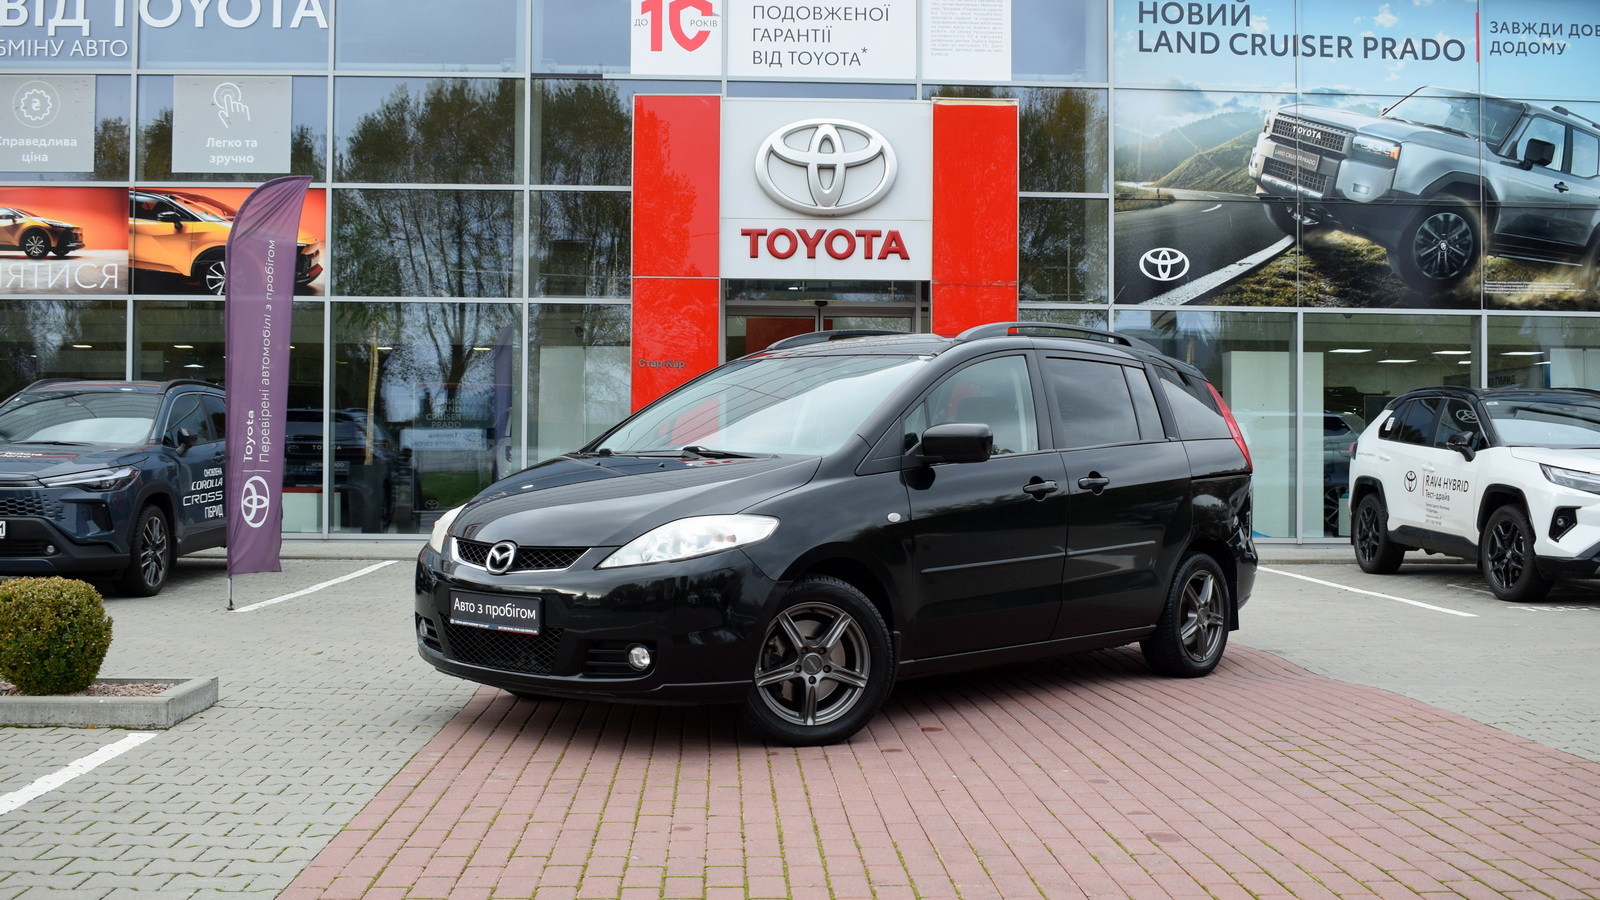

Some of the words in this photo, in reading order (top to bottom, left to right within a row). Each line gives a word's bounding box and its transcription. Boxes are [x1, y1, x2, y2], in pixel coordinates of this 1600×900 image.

[0, 0, 90, 36] ВІД
[752, 4, 891, 23] ПОДОВЖЕНОЇ
[1138, 0, 1251, 26] НОВИЙ
[752, 26, 833, 43] ГАРАНТІЇ
[1489, 21, 1563, 38] ЗАВЖДИ
[70, 40, 129, 57] АВТО
[1138, 30, 1221, 55] LAND
[1229, 32, 1354, 59] CRUISER
[1363, 36, 1466, 62] PRADO
[1489, 41, 1567, 57] ДОДОМУ
[752, 50, 783, 68] ВІД
[1292, 125, 1322, 140] TOYOTA
[206, 137, 242, 149] Легко
[245, 139, 258, 148] та
[22, 152, 49, 163] ціна
[209, 154, 255, 165] зручно
[1274, 149, 1286, 157] LAND
[740, 228, 911, 261] TOYOTA
[0, 262, 118, 289] ЯТИСЯ
[264, 240, 276, 300] пробігом
[261, 314, 272, 386] автомобілі
[638, 359, 685, 369] Стар-Кар
[426, 413, 461, 421] CRUISER
[431, 421, 461, 429] PRADO
[259, 389, 271, 463] Перевірені
[243, 410, 256, 462] Toyota
[191, 477, 223, 491] COROLLA
[1425, 474, 1442, 488] RAV4
[1443, 477, 1470, 493] HYBRID
[183, 490, 223, 507] CROSS
[1425, 489, 1451, 502] Тест-драйв
[453, 596, 476, 613] Авто
[477, 603, 483, 614] з
[485, 601, 536, 620] пробігом
